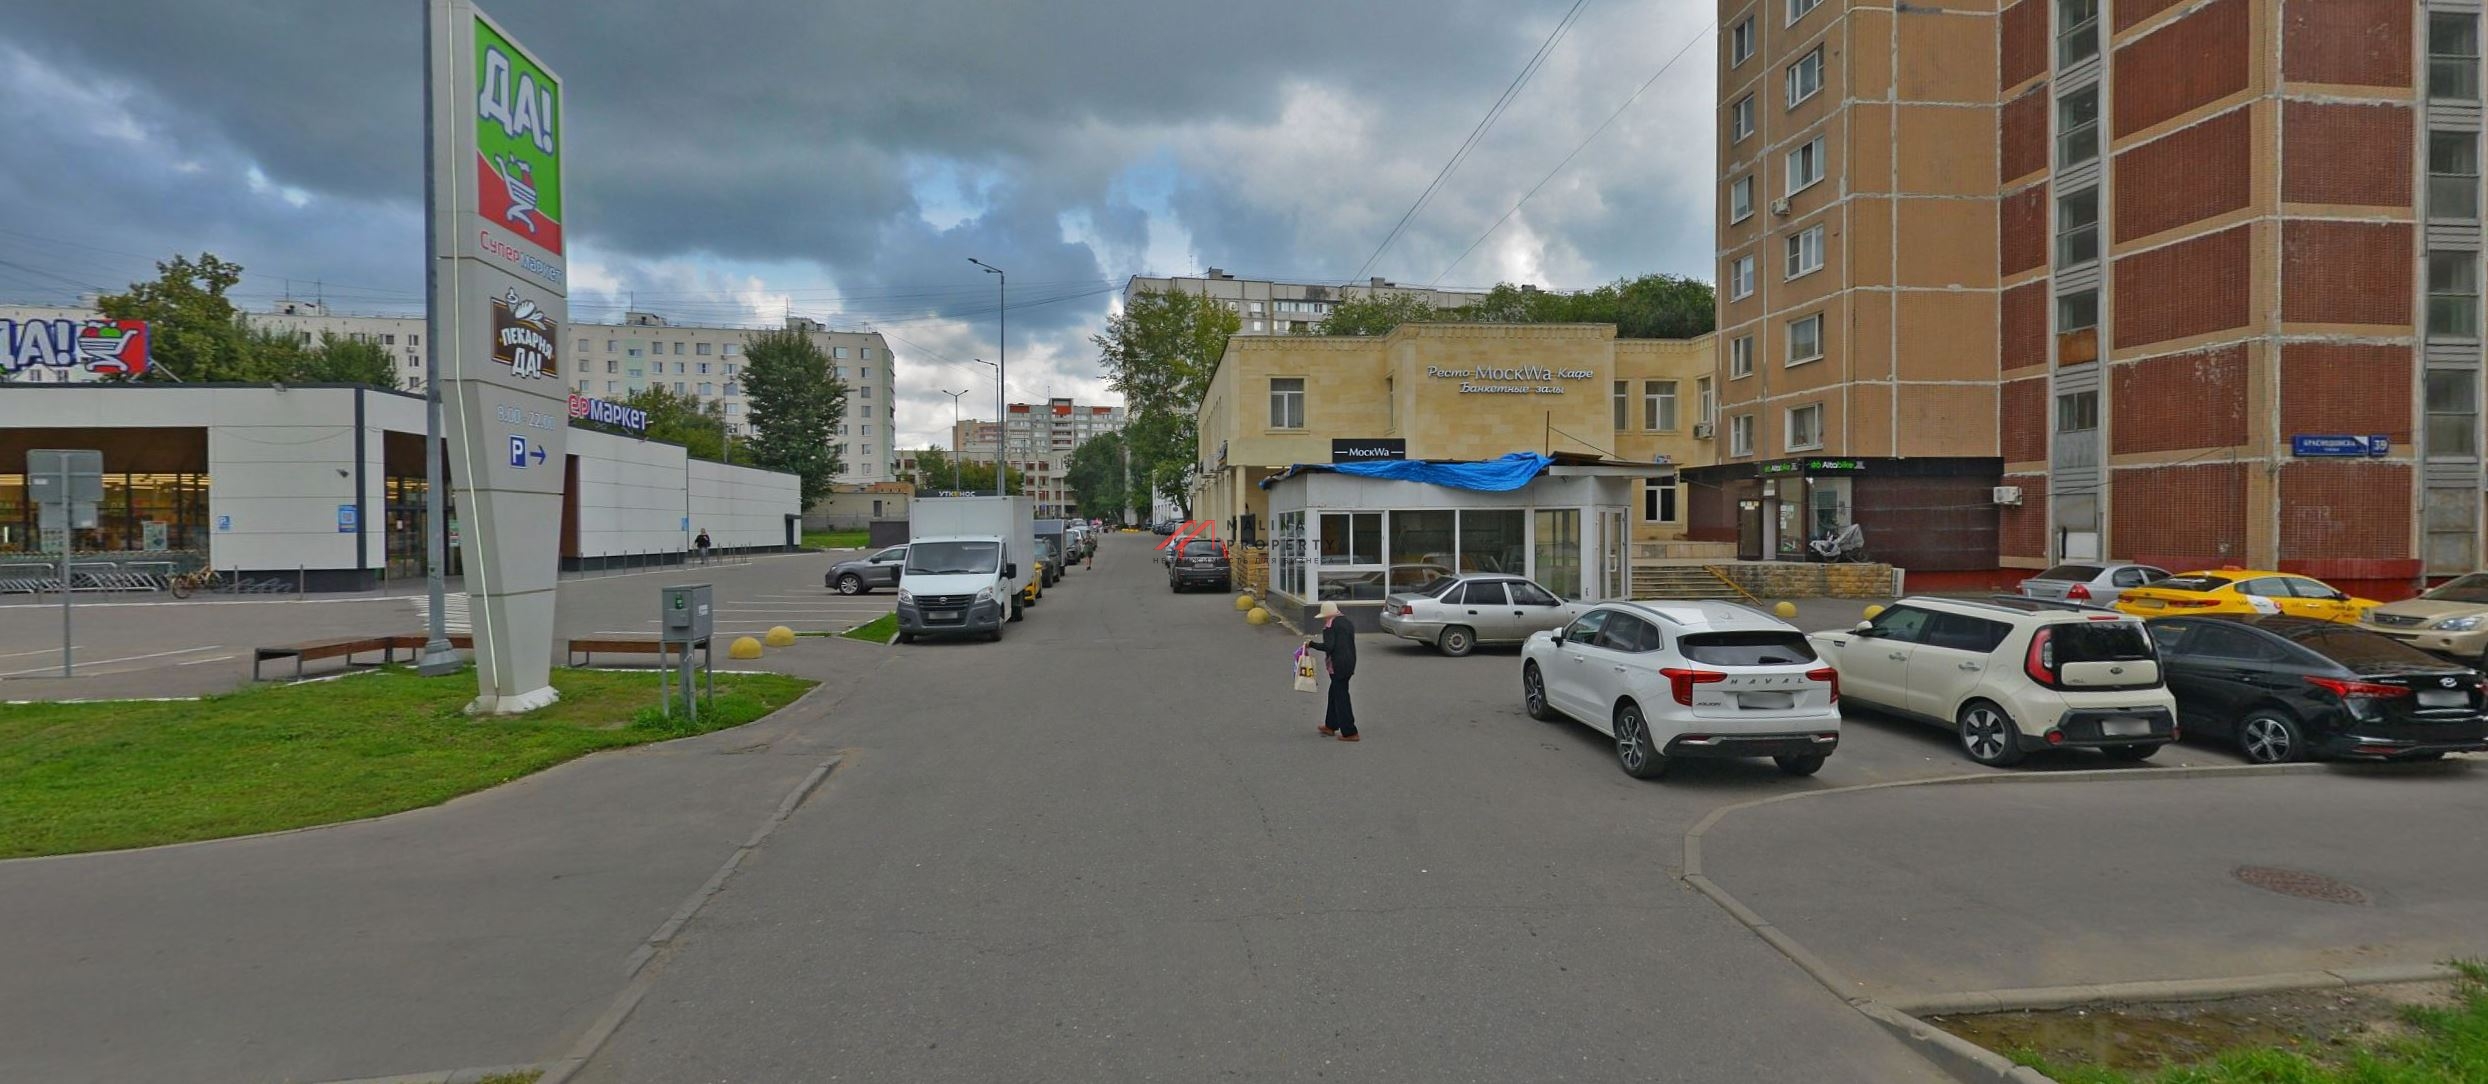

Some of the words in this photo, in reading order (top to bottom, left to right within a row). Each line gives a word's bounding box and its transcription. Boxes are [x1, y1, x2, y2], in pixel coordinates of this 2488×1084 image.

[478, 46, 553, 156] ДА!
[480, 230, 564, 284] Супермаркет
[501, 327, 553, 360] ПЕКАРНЯ
[511, 347, 541, 379] ДА!
[1427, 365, 1471, 378] Ресто
[1556, 367, 1593, 380] Кафе
[1459, 381, 1530, 394] Банкетные
[1535, 385, 1565, 394] залы
[568, 393, 648, 431] ермаркет
[2375, 440, 2388, 450] 39
